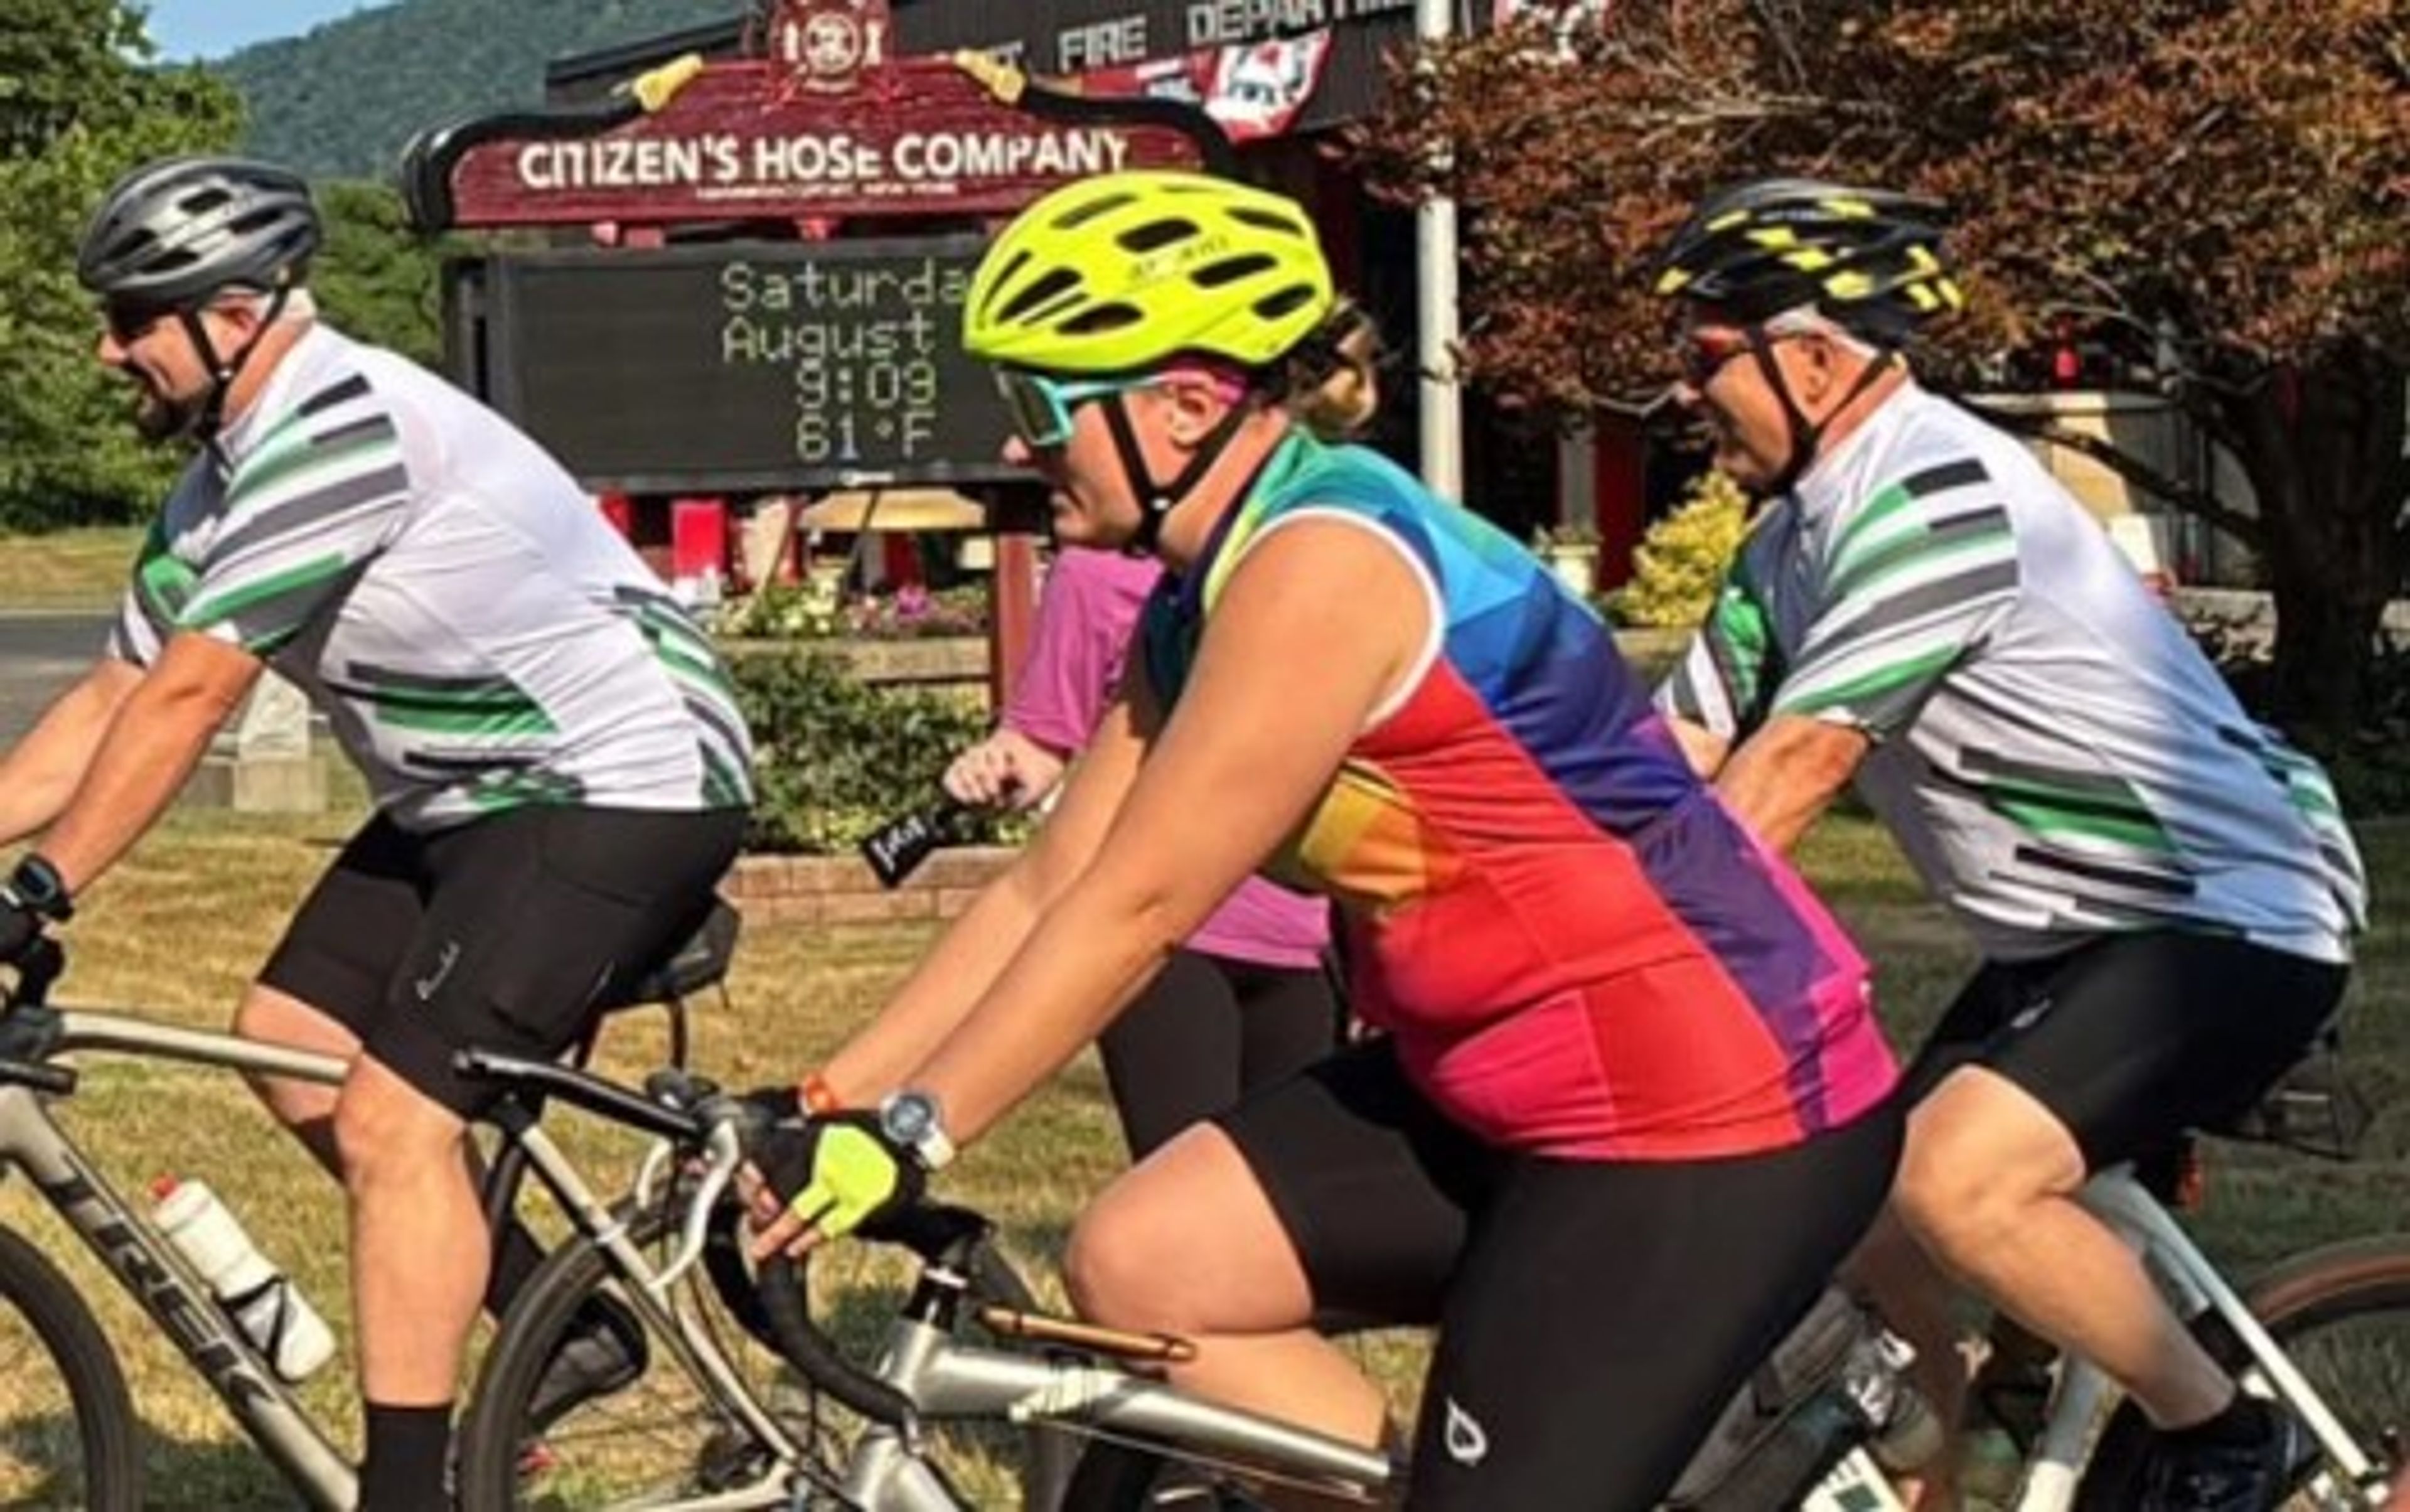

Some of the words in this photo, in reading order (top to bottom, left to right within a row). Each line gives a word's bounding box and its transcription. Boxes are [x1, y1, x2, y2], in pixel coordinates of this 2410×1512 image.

[1058, 14, 1147, 73] FIRE
[518, 134, 739, 188] CITIZEN'S
[754, 134, 882, 180] HOSE
[894, 131, 1127, 176] COMPANY
[723, 311, 935, 363] August
[796, 359, 936, 409] 9:09
[796, 411, 936, 460] 61°F
[53, 1152, 276, 1406] TREK
